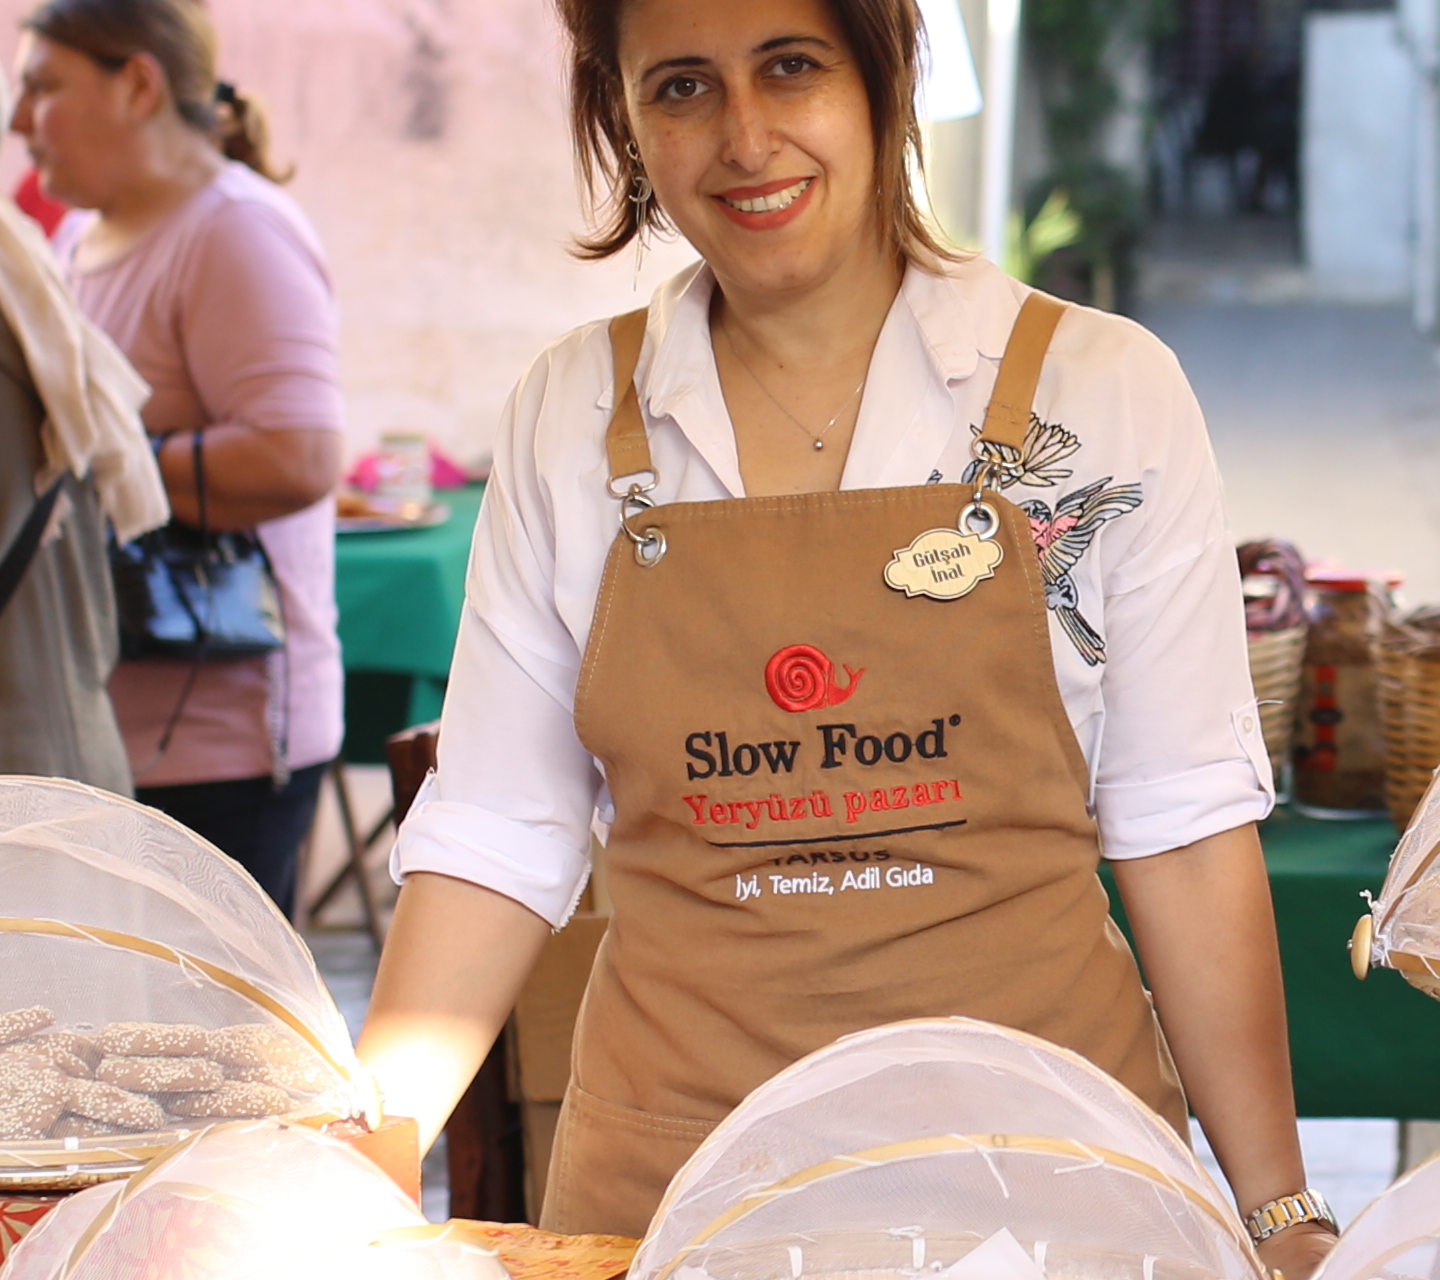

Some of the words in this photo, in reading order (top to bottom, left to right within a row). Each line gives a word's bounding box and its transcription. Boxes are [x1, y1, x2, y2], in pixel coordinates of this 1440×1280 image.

[685, 730, 801, 780] Slow
[682, 790, 834, 829] Yeryüzü
[843, 780, 963, 823] pazarı
[767, 850, 891, 866] TARSUS
[768, 871, 836, 895] Temiz,
[840, 865, 882, 891] Adil
[885, 863, 935, 887] Gıda
